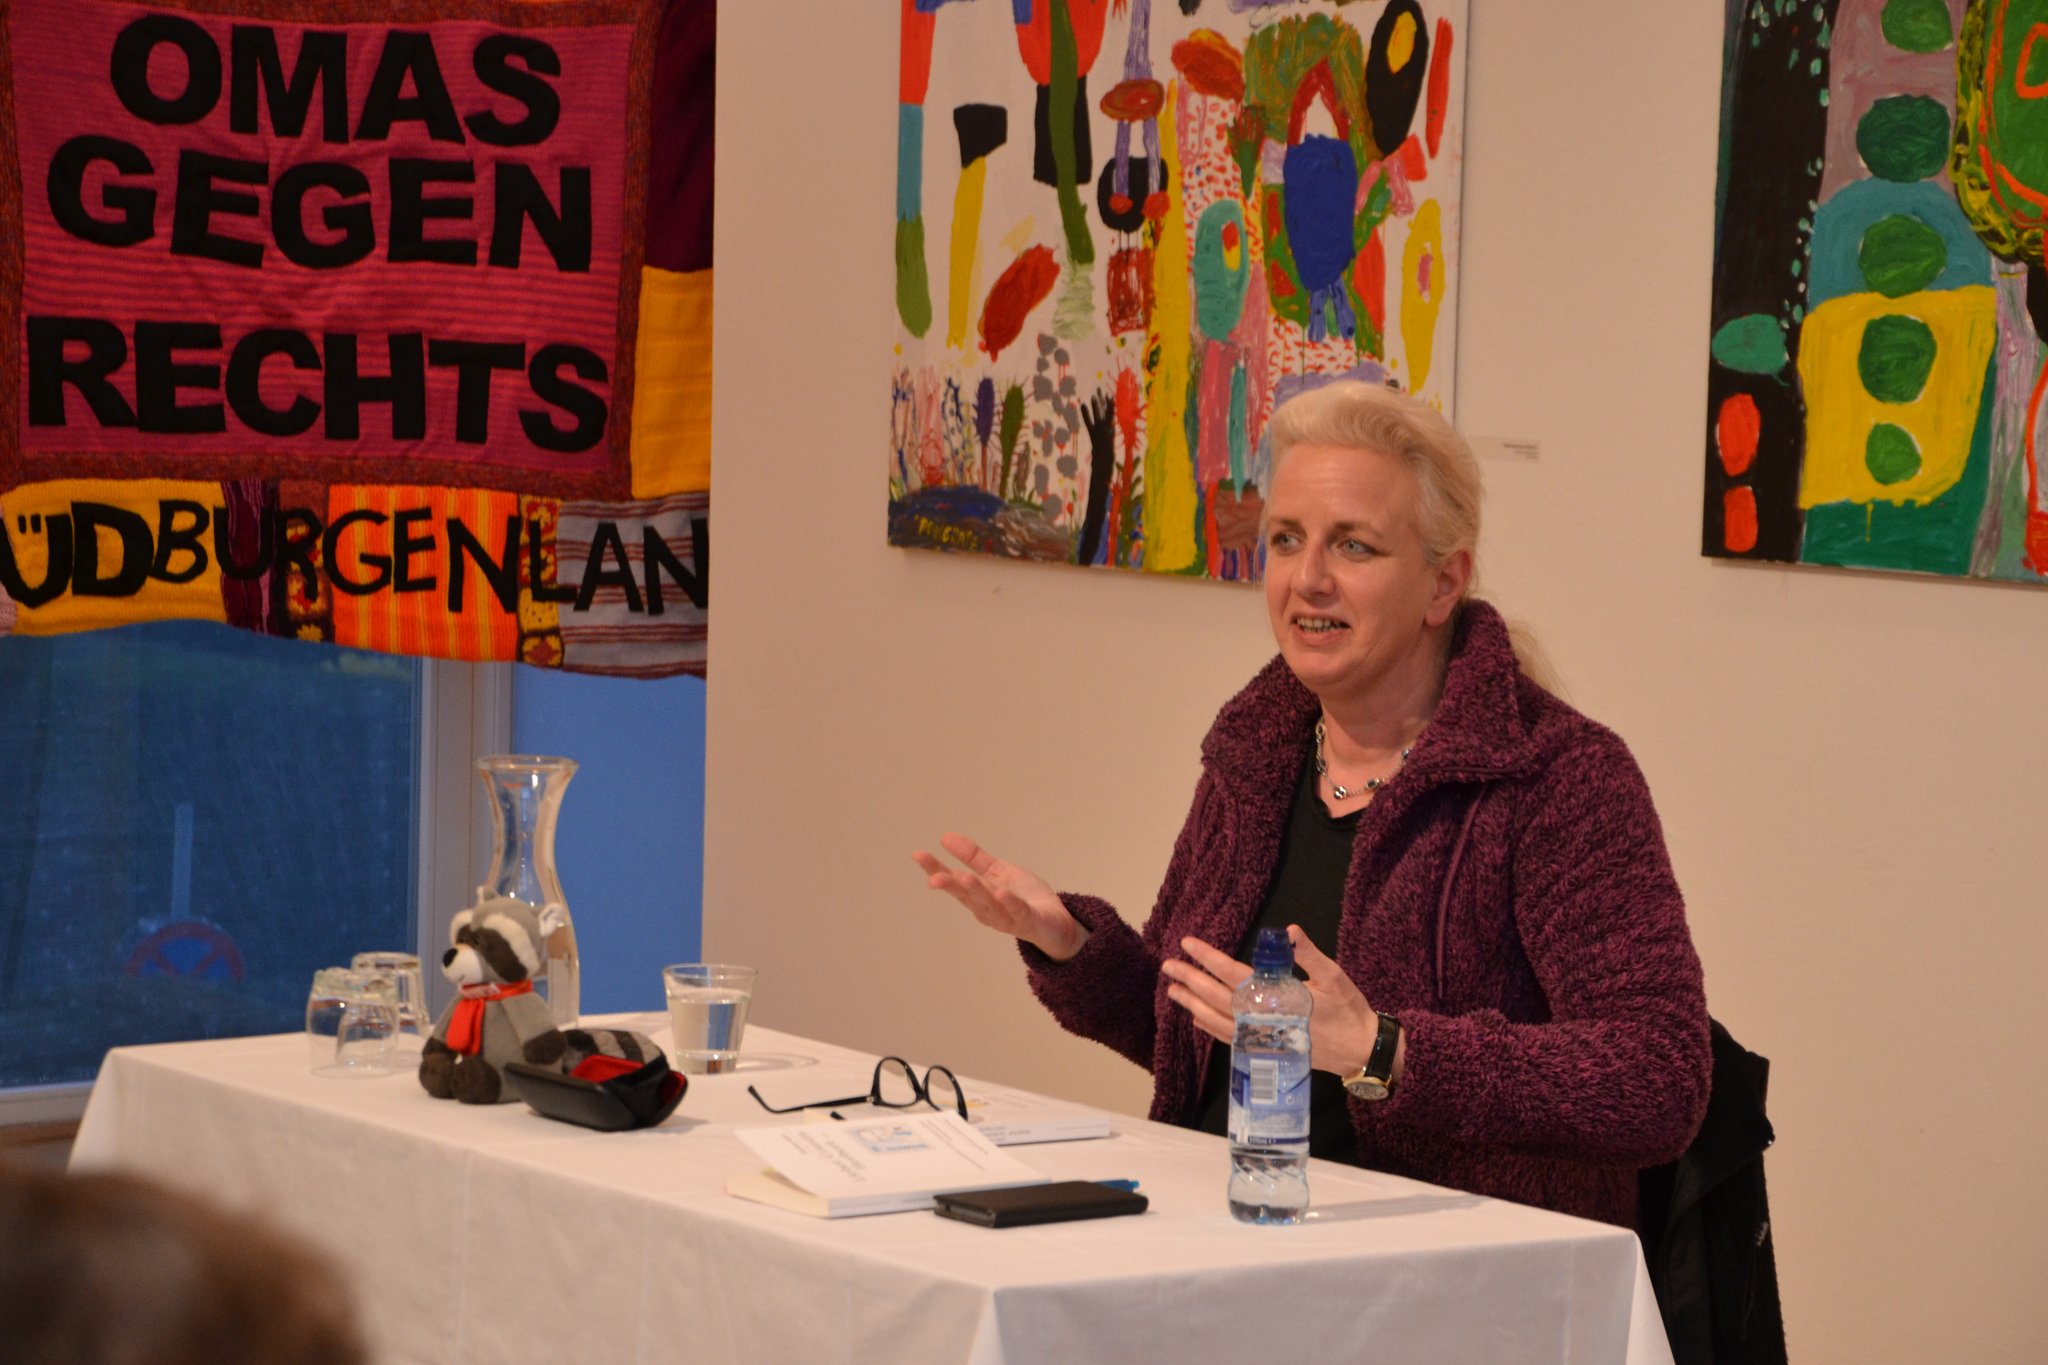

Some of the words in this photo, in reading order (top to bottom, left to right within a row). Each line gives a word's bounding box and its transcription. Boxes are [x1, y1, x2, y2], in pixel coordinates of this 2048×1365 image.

[110, 14, 562, 147] OMAS
[46, 135, 592, 272] GEGEN
[26, 315, 609, 453] RECHTS
